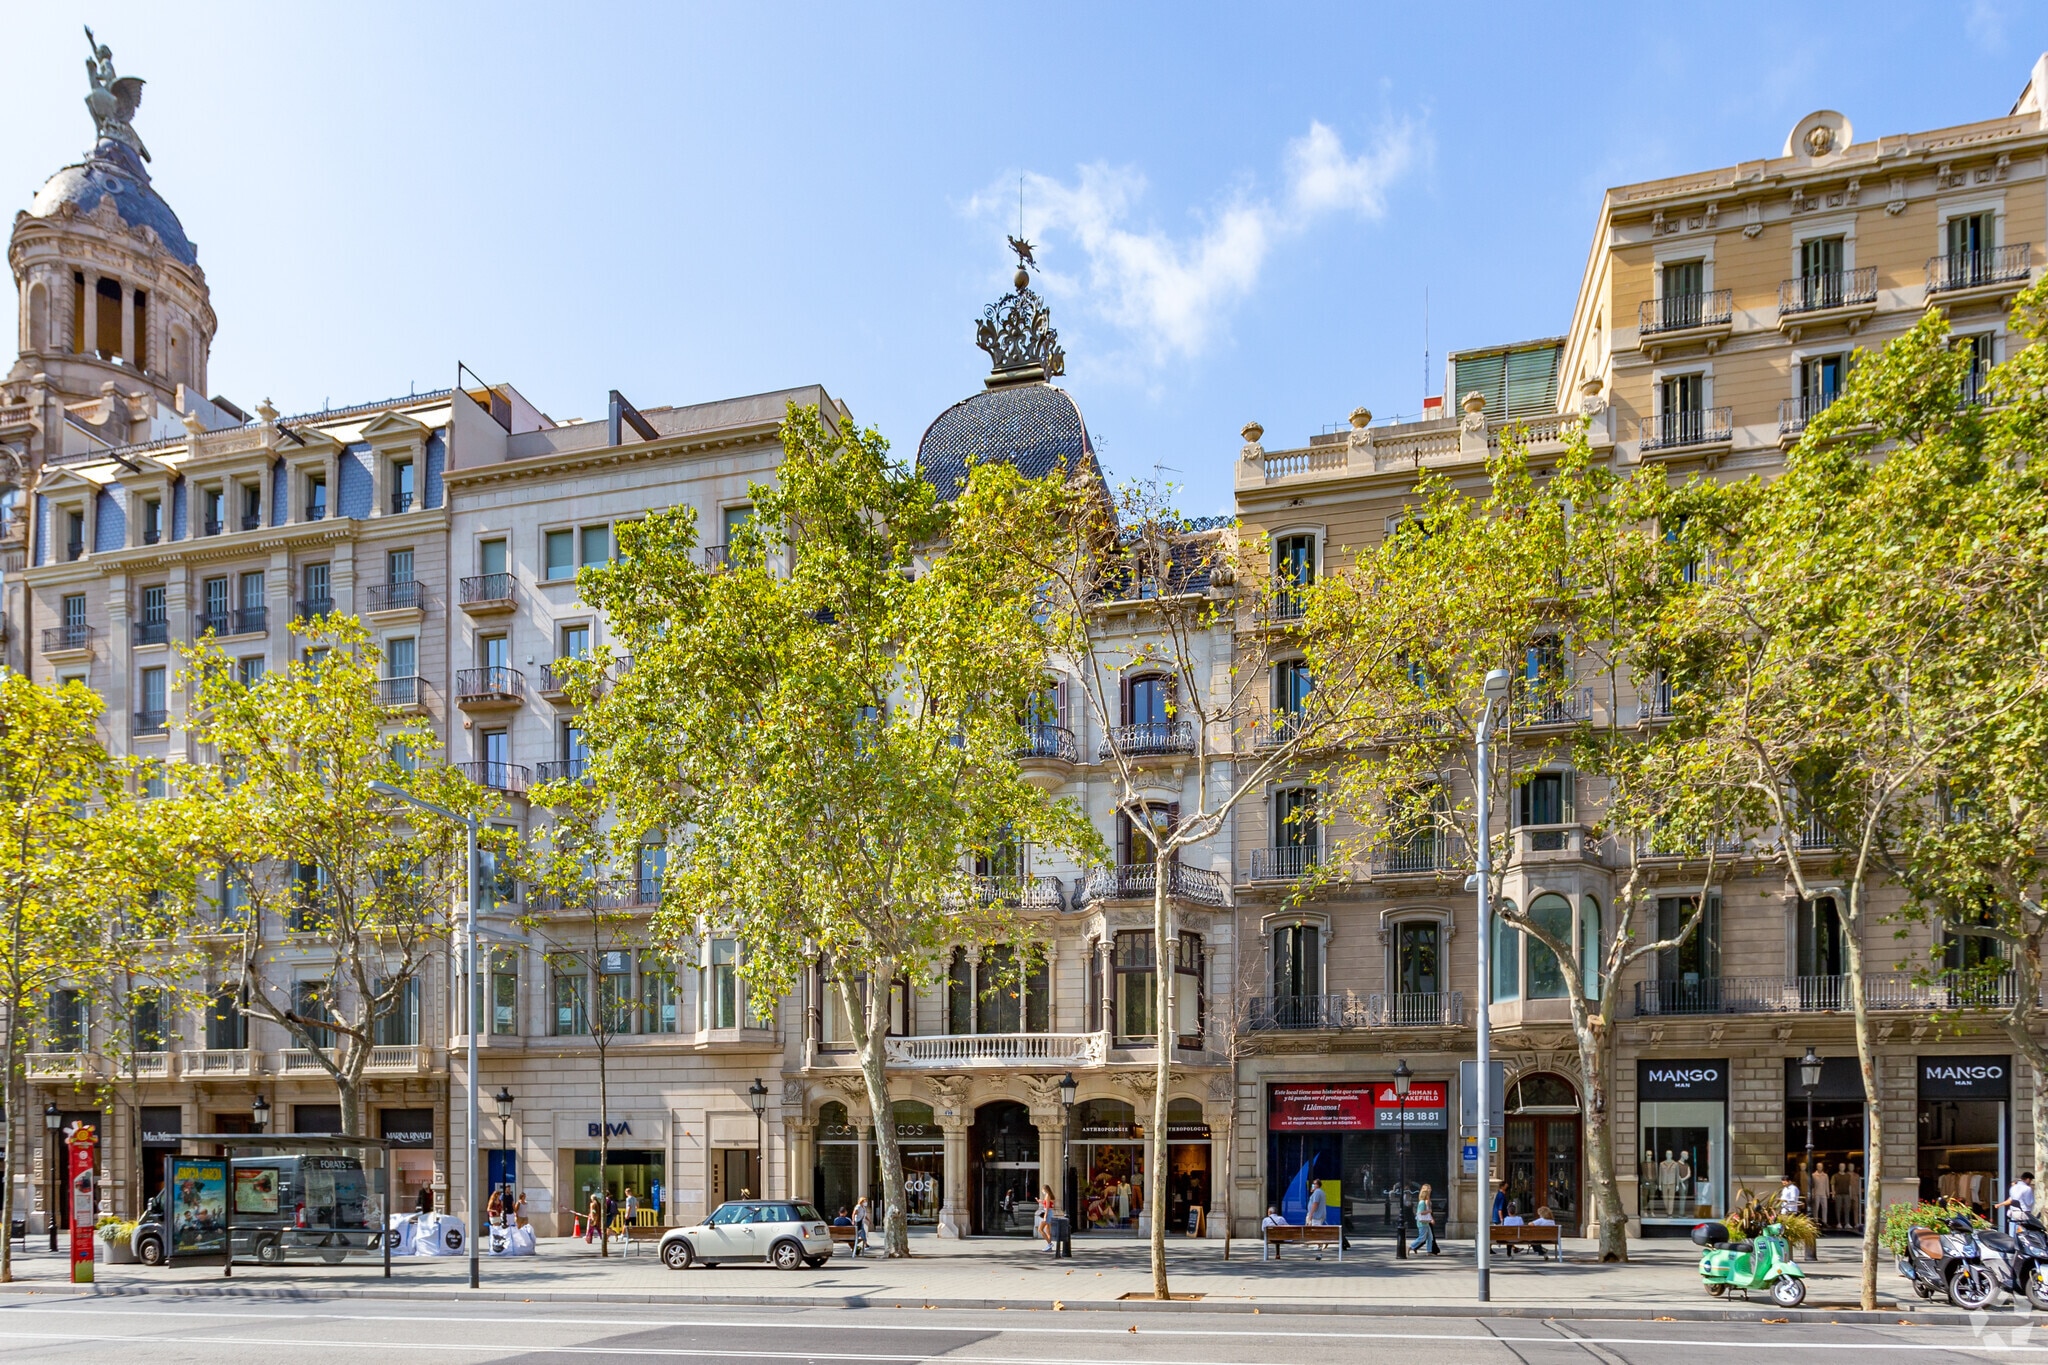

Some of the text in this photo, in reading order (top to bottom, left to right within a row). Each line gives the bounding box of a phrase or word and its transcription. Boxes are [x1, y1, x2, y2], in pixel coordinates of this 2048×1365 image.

[1649, 1069, 1718, 1082] MANGO
[1926, 1066, 2003, 1079] MANGO
[1380, 1112, 1393, 1120] 93
[1396, 1112, 1415, 1120] 488
[588, 1121, 632, 1137] BBVA
[826, 1125, 852, 1136] COS
[897, 1125, 924, 1136] COS
[386, 1131, 433, 1141] MARINA RINALDI
[320, 1160, 347, 1169] FORATS
[904, 1180, 932, 1191] COS
